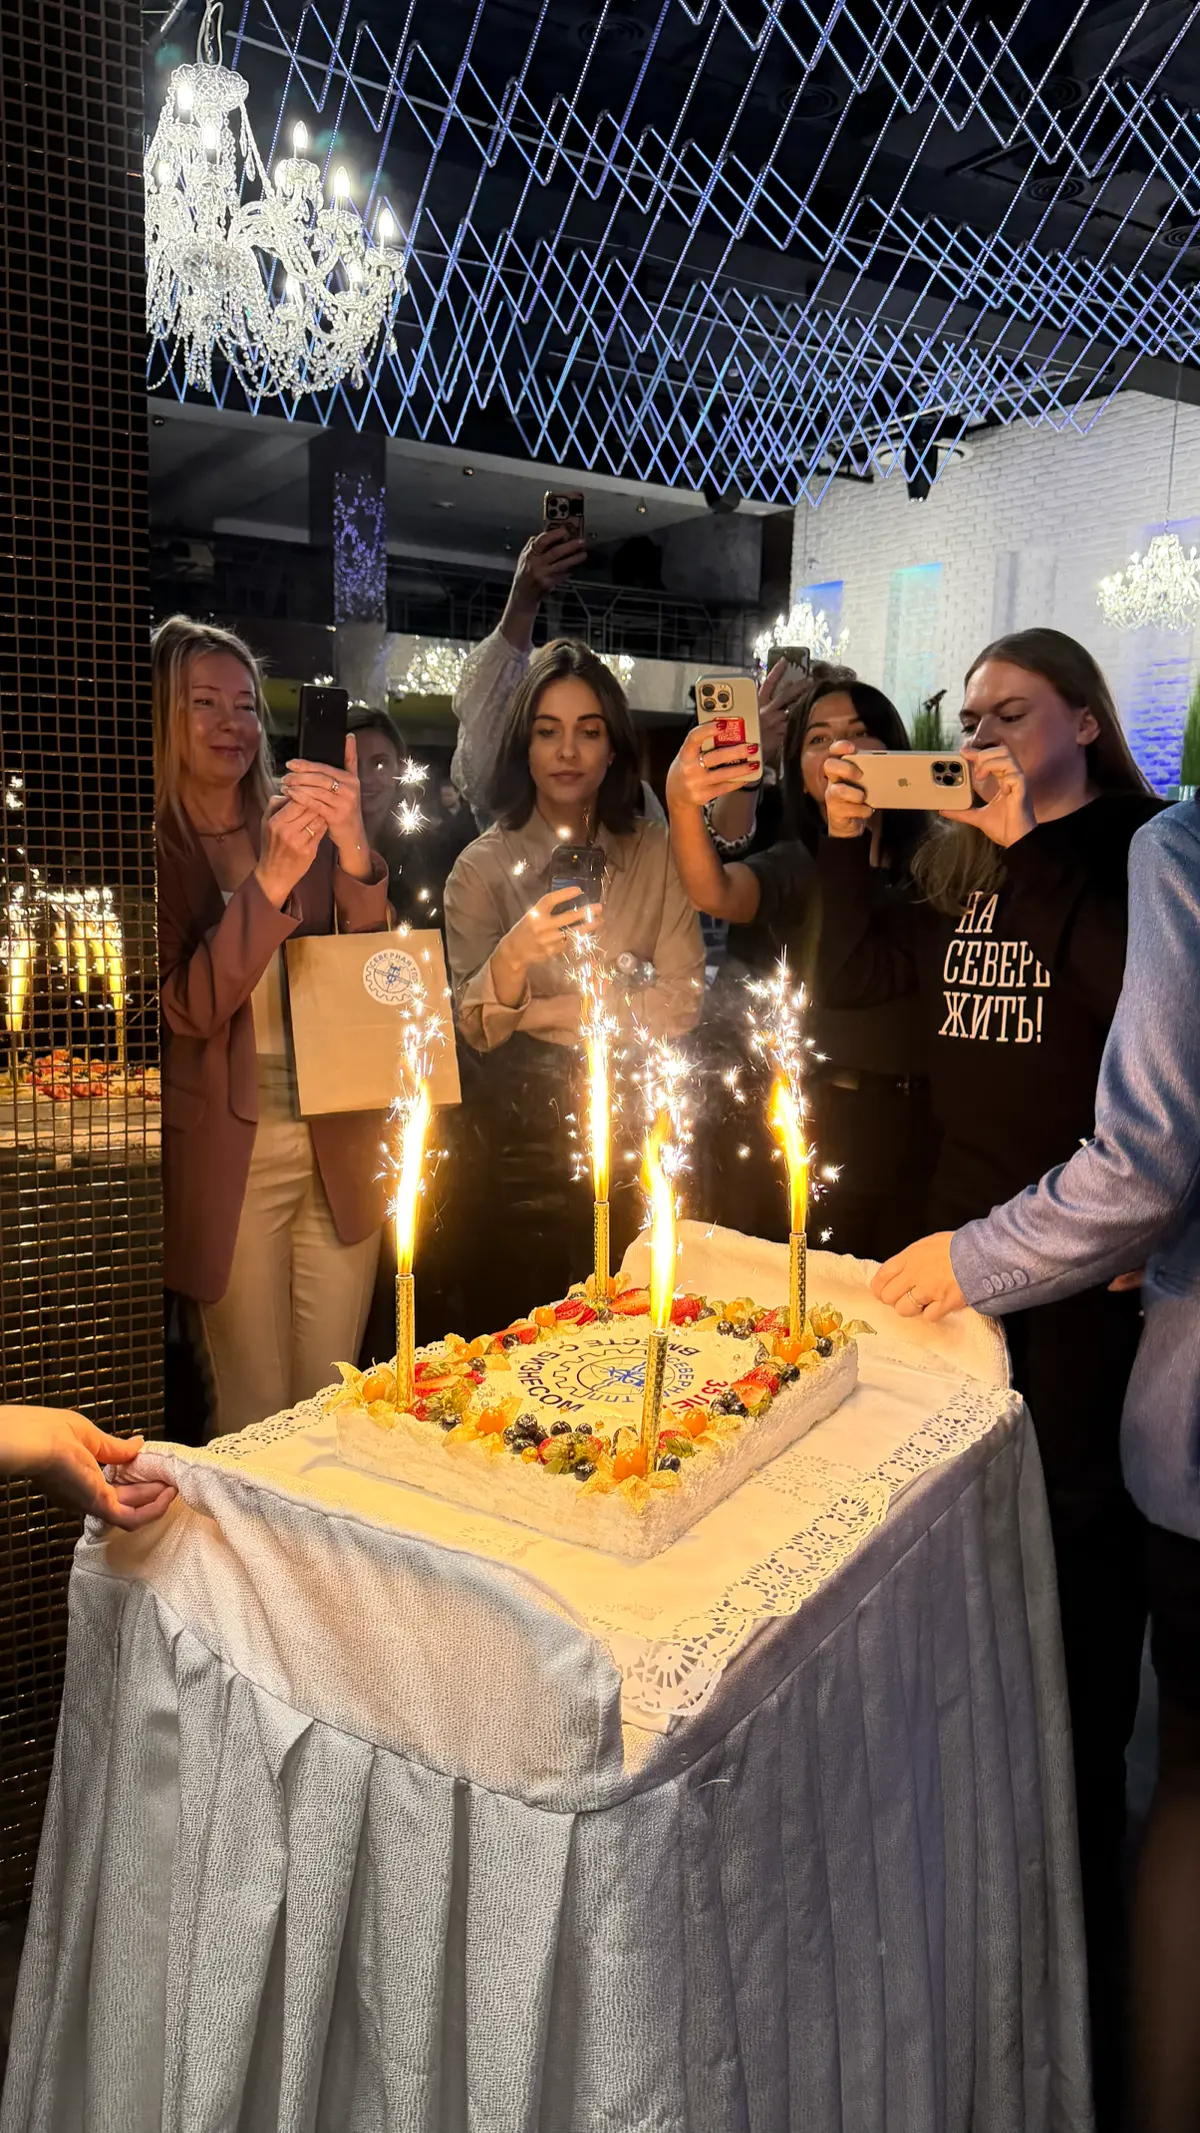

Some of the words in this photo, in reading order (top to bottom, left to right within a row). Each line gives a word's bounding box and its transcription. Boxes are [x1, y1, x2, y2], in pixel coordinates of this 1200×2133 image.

[955, 891, 999, 933] НА
[369, 952, 412, 969] СЕВЕРНАЯ
[938, 991, 1043, 1043] ЖИТЬ!
[558, 1343, 579, 1352] С
[518, 1351, 585, 1412] БИЗНЕСОМ
[663, 1356, 695, 1398] СЕВЕРНА
[701, 1379, 729, 1395] 35
[588, 1393, 634, 1402] ТПП
